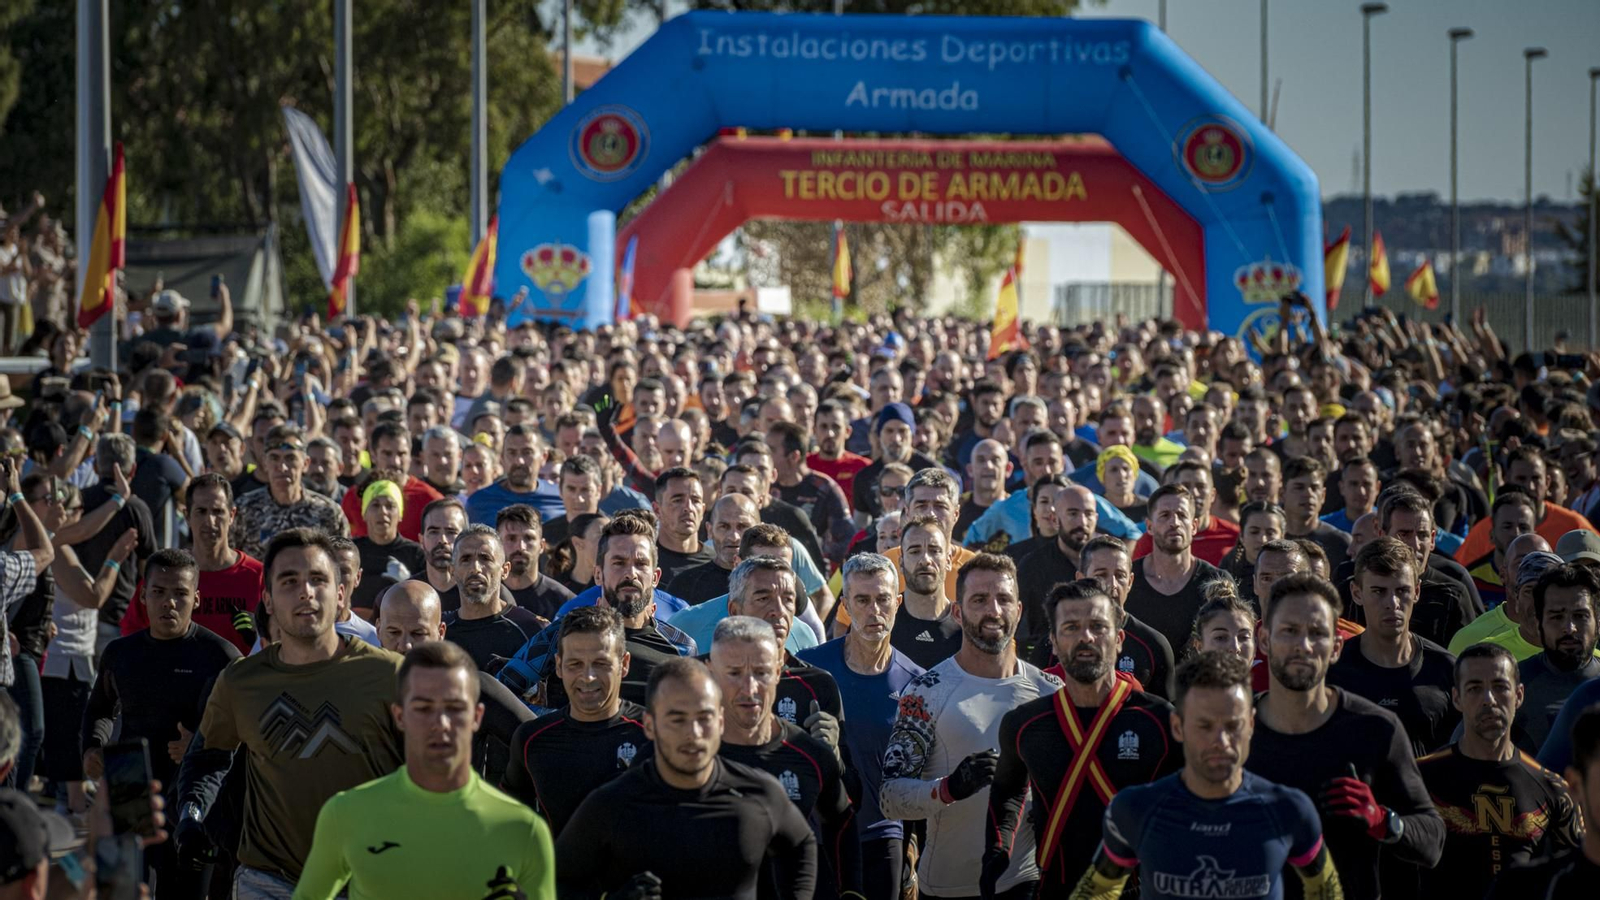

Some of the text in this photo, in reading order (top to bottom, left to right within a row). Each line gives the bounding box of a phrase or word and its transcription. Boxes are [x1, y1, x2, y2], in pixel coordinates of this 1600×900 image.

[697, 29, 1131, 71] Instalaciones Deportivas
[845, 79, 980, 111] Armada
[936, 151, 965, 169] DE
[968, 151, 1058, 170] MARINA
[779, 169, 1088, 202] TERCIO DE ARMADA
[880, 200, 988, 222] SALIDA
[1471, 784, 1515, 833] Ñ
